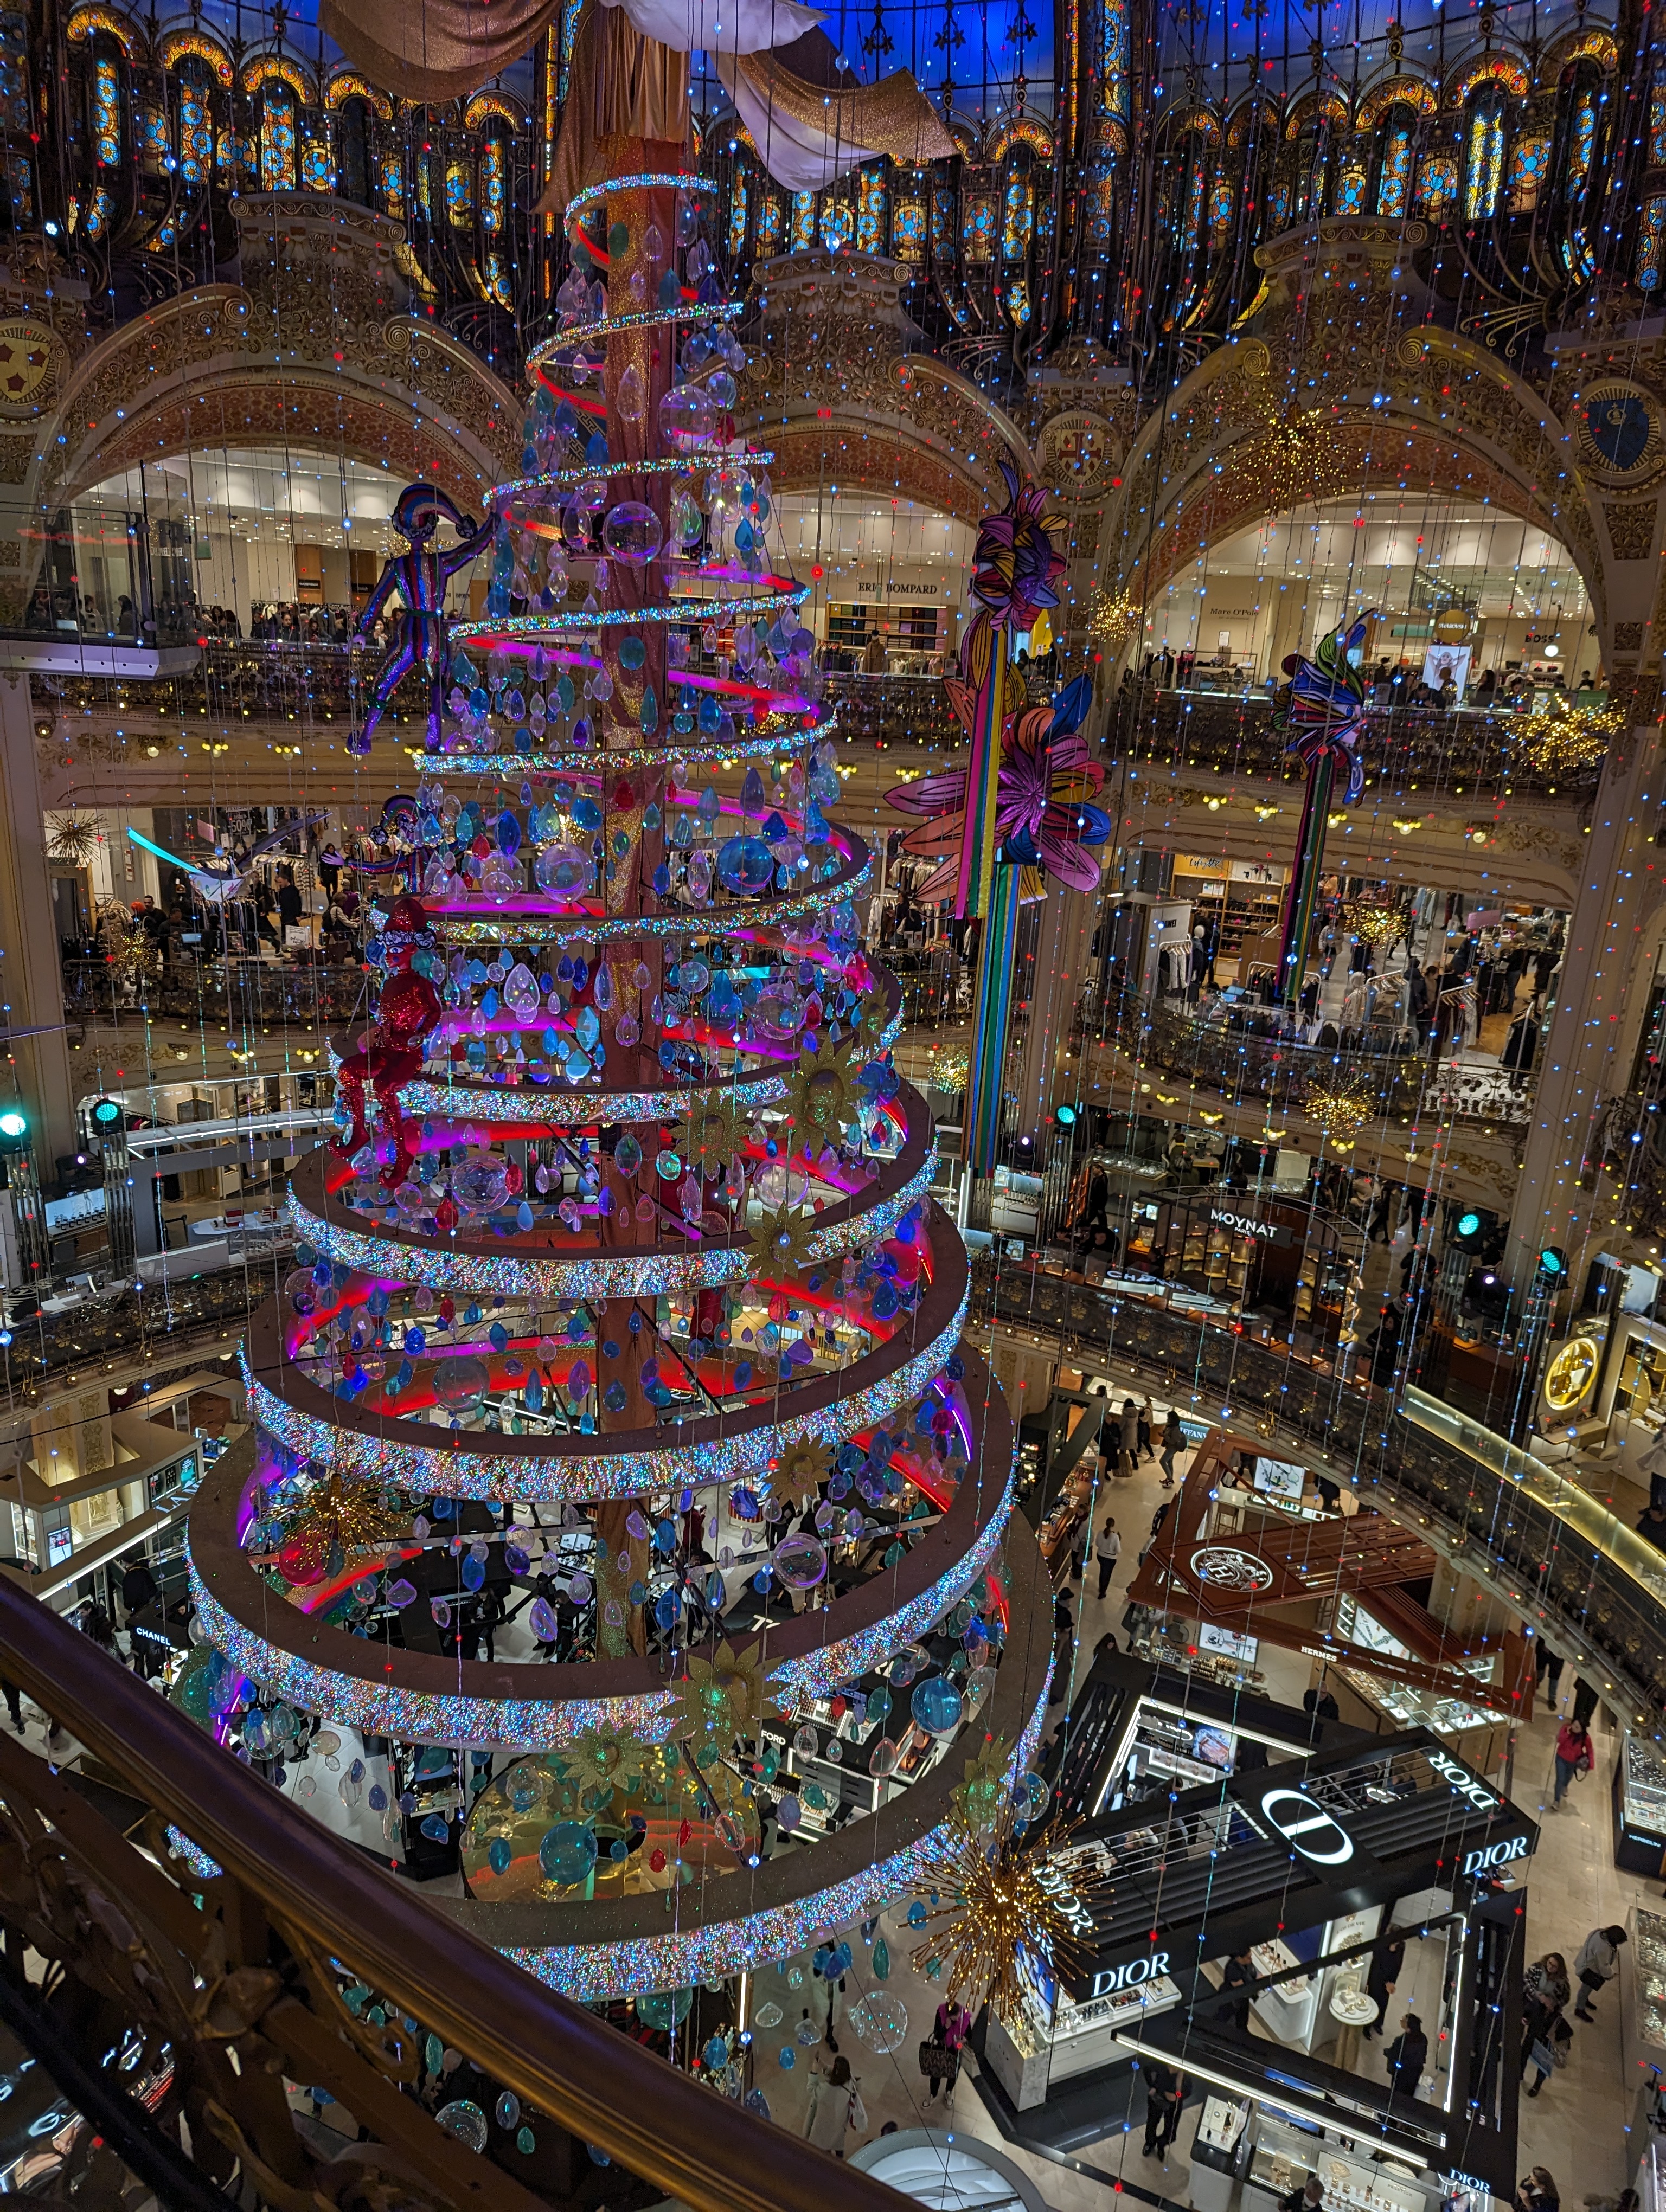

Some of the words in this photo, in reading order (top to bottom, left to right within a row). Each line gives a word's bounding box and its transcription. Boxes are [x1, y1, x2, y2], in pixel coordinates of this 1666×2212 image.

[886, 583, 937, 594] BOMPARD
[1525, 635, 1555, 643] BOSS
[1211, 1208, 1278, 1238] MOYNAT
[1234, 1227, 1251, 1237] PARIS
[136, 1627, 170, 1646] CHANEL
[761, 1729, 786, 1745] FORD
[1428, 1751, 1500, 1810] DIOR
[1462, 1837, 1527, 1875] DIOR
[1091, 1952, 1171, 1998] DIOR
[1450, 2169, 1491, 2194] DIOR
